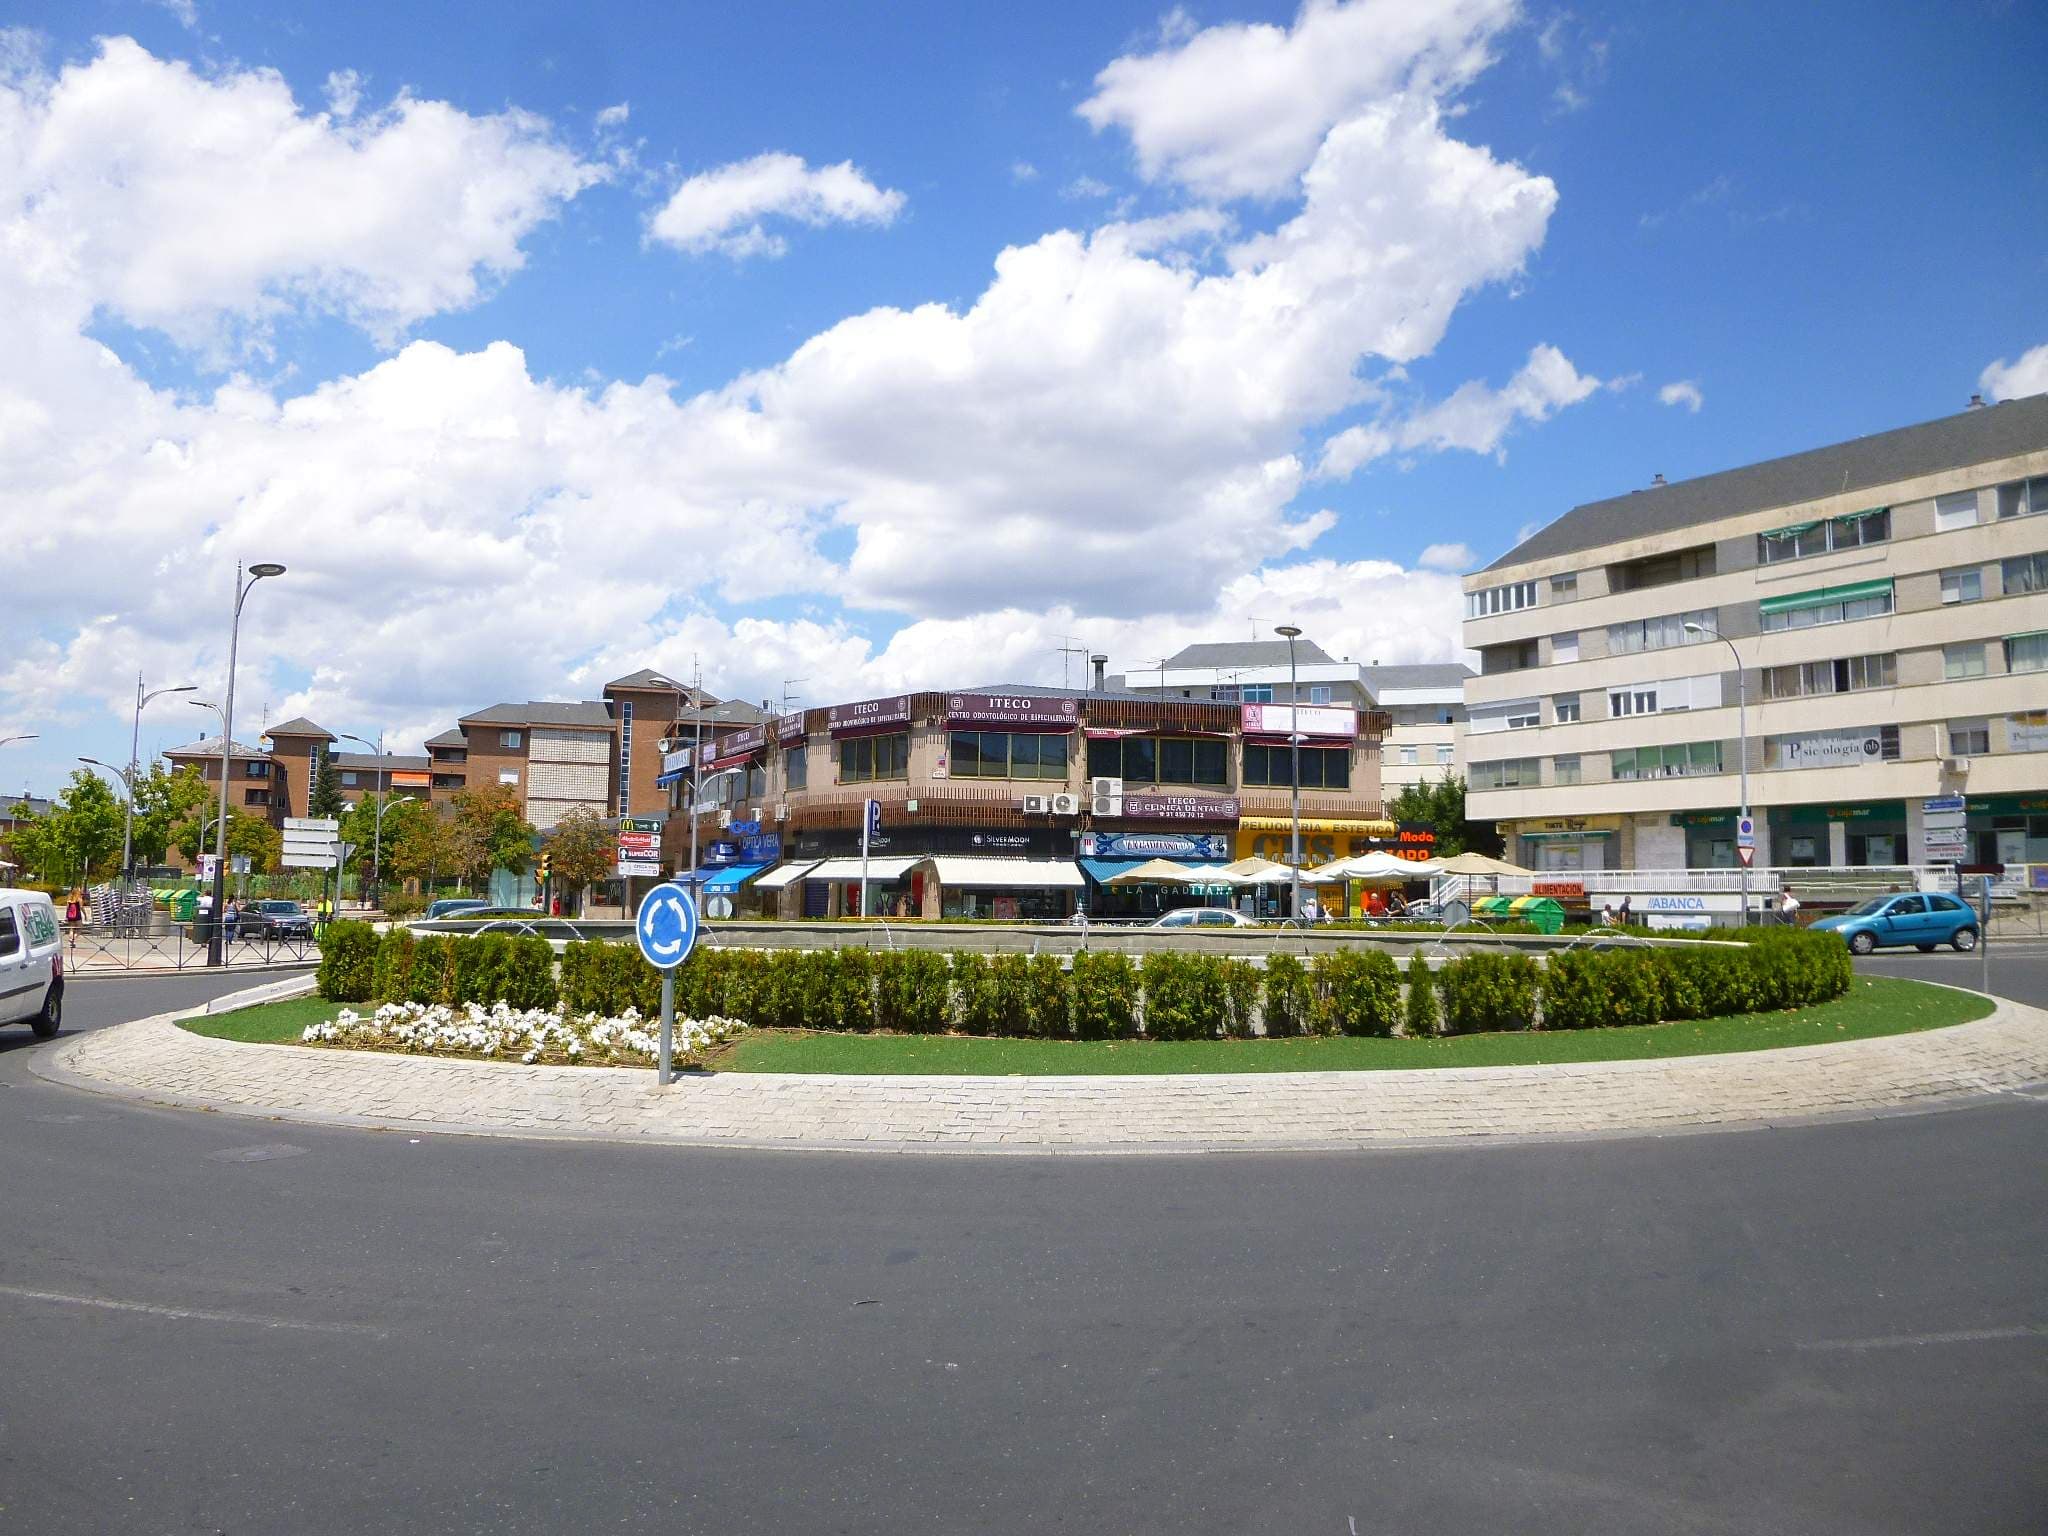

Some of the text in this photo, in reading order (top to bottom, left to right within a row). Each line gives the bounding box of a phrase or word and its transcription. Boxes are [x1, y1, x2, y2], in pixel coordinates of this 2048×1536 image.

[854, 702, 879, 715] ITECO
[989, 698, 1031, 709] ITECO
[948, 711, 970, 719] CENTRO
[1167, 797, 1197, 805] ITECO
[1184, 804, 1219, 813] DENTAL
[1241, 820, 1322, 833] PELUQURIA
[1400, 831, 1436, 843] Moda
[1126, 885, 1143, 894] LA
[1534, 883, 1583, 896] ALIMENTACION
[1653, 897, 1704, 909] ABANCA
